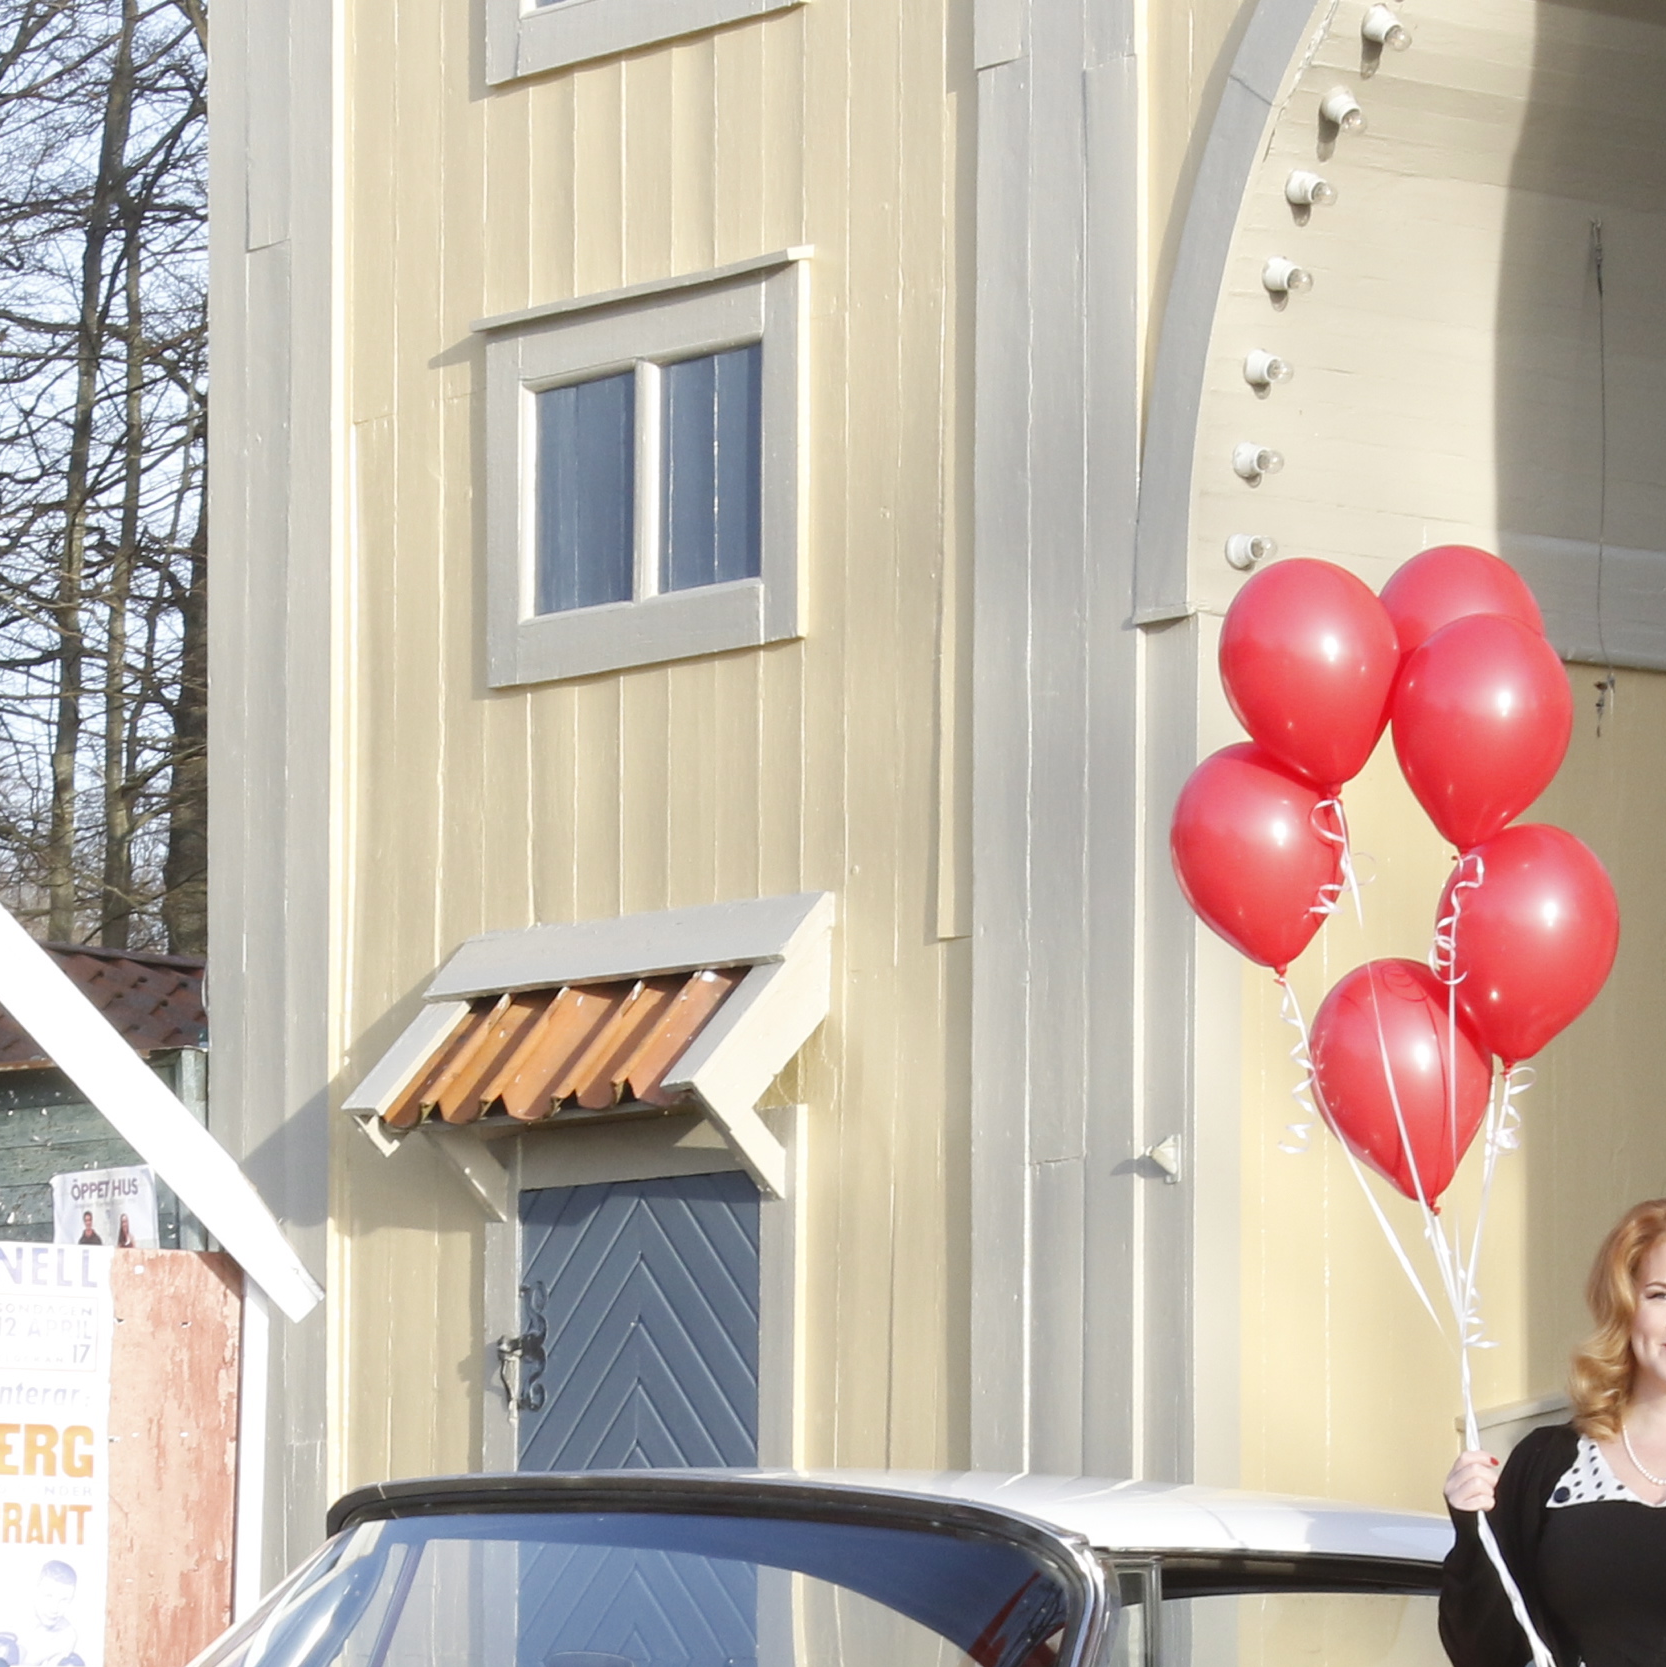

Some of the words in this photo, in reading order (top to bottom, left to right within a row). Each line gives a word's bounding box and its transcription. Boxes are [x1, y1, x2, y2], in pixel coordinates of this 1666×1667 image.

[71, 1178, 109, 1201] ÖPPET
[111, 1177, 138, 1198] HUS
[72, 1344, 91, 1364] 17
